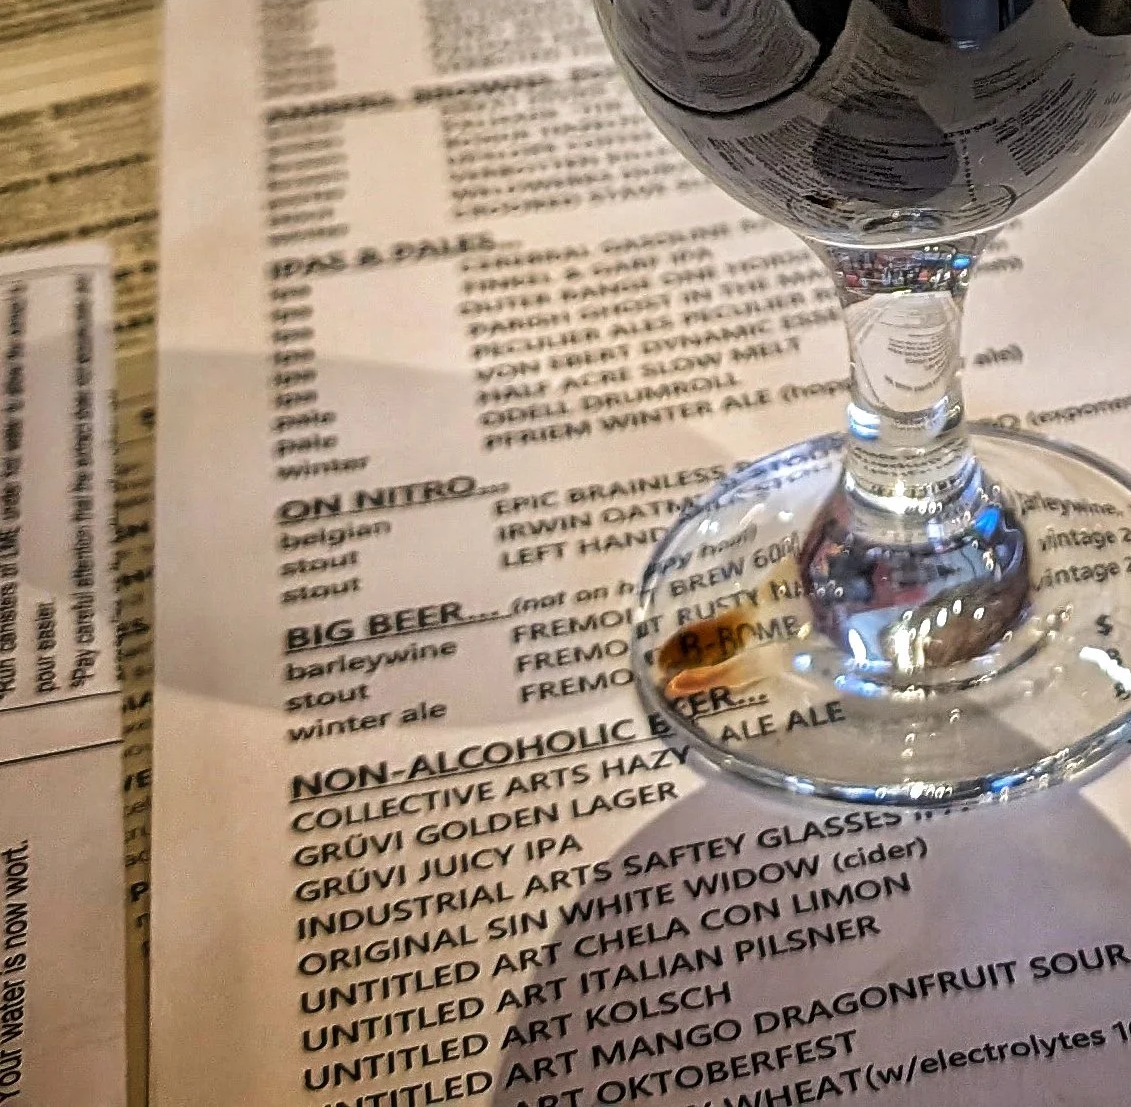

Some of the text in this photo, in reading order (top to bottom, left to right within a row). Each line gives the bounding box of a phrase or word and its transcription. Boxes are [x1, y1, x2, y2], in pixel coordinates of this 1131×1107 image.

[278, 493, 343, 522] ON
[493, 463, 728, 517] EPIC BRAINLESS
[280, 519, 392, 550] belgian
[280, 549, 360, 577] stout
[501, 540, 567, 569] LEFT
[282, 576, 362, 604] stout
[285, 640, 459, 681] barleywine
[669, 557, 746, 597] BREW
[286, 617, 356, 651] BIG
[35, 656, 60, 694] pour
[285, 683, 371, 712] stout
[288, 701, 448, 741] winter ale
[290, 717, 637, 802] NON-ALCOHOLIC
[291, 780, 496, 833] COLLECTIVE
[504, 763, 592, 797] ARTS
[602, 744, 690, 779] HAZY
[787, 700, 847, 732] ALE
[293, 781, 678, 869] GRÜVI GOLDEN LAGER
[3, 839, 29, 899] wort.
[294, 864, 408, 903] GRÜVI
[418, 842, 516, 883] JUICY
[525, 833, 584, 862] IPA
[296, 880, 514, 940] INDUSTRIAL
[523, 860, 612, 898] ARTS
[623, 831, 746, 877] SAFTEY
[2, 903, 28, 950] now
[297, 923, 479, 977] ORIGINAL
[486, 908, 549, 942] SIN
[561, 881, 677, 927] WHITE
[683, 853, 821, 900] WIDOW
[832, 835, 930, 874] (cider)
[0, 953, 27, 975] is
[300, 959, 482, 1015] UNTITLED
[491, 941, 563, 978] ART
[573, 916, 691, 959] CHELA
[700, 896, 782, 933] CON
[791, 871, 913, 915] LIMON
[0, 980, 25, 1043] water
[302, 996, 486, 1053] UNTITLED
[496, 976, 568, 1014] ART
[578, 944, 726, 995] ITALIAN
[734, 913, 883, 963] PILSNER
[303, 1032, 490, 1091] UNTITLED
[500, 1011, 574, 1051] ART
[584, 979, 733, 1033] KOLSCH
[504, 1048, 579, 1089] ART
[590, 1018, 743, 1069] MANGO
[753, 959, 1018, 1036] DRAGONFRUIT
[596, 1028, 858, 1105] OKTOBERFEST
